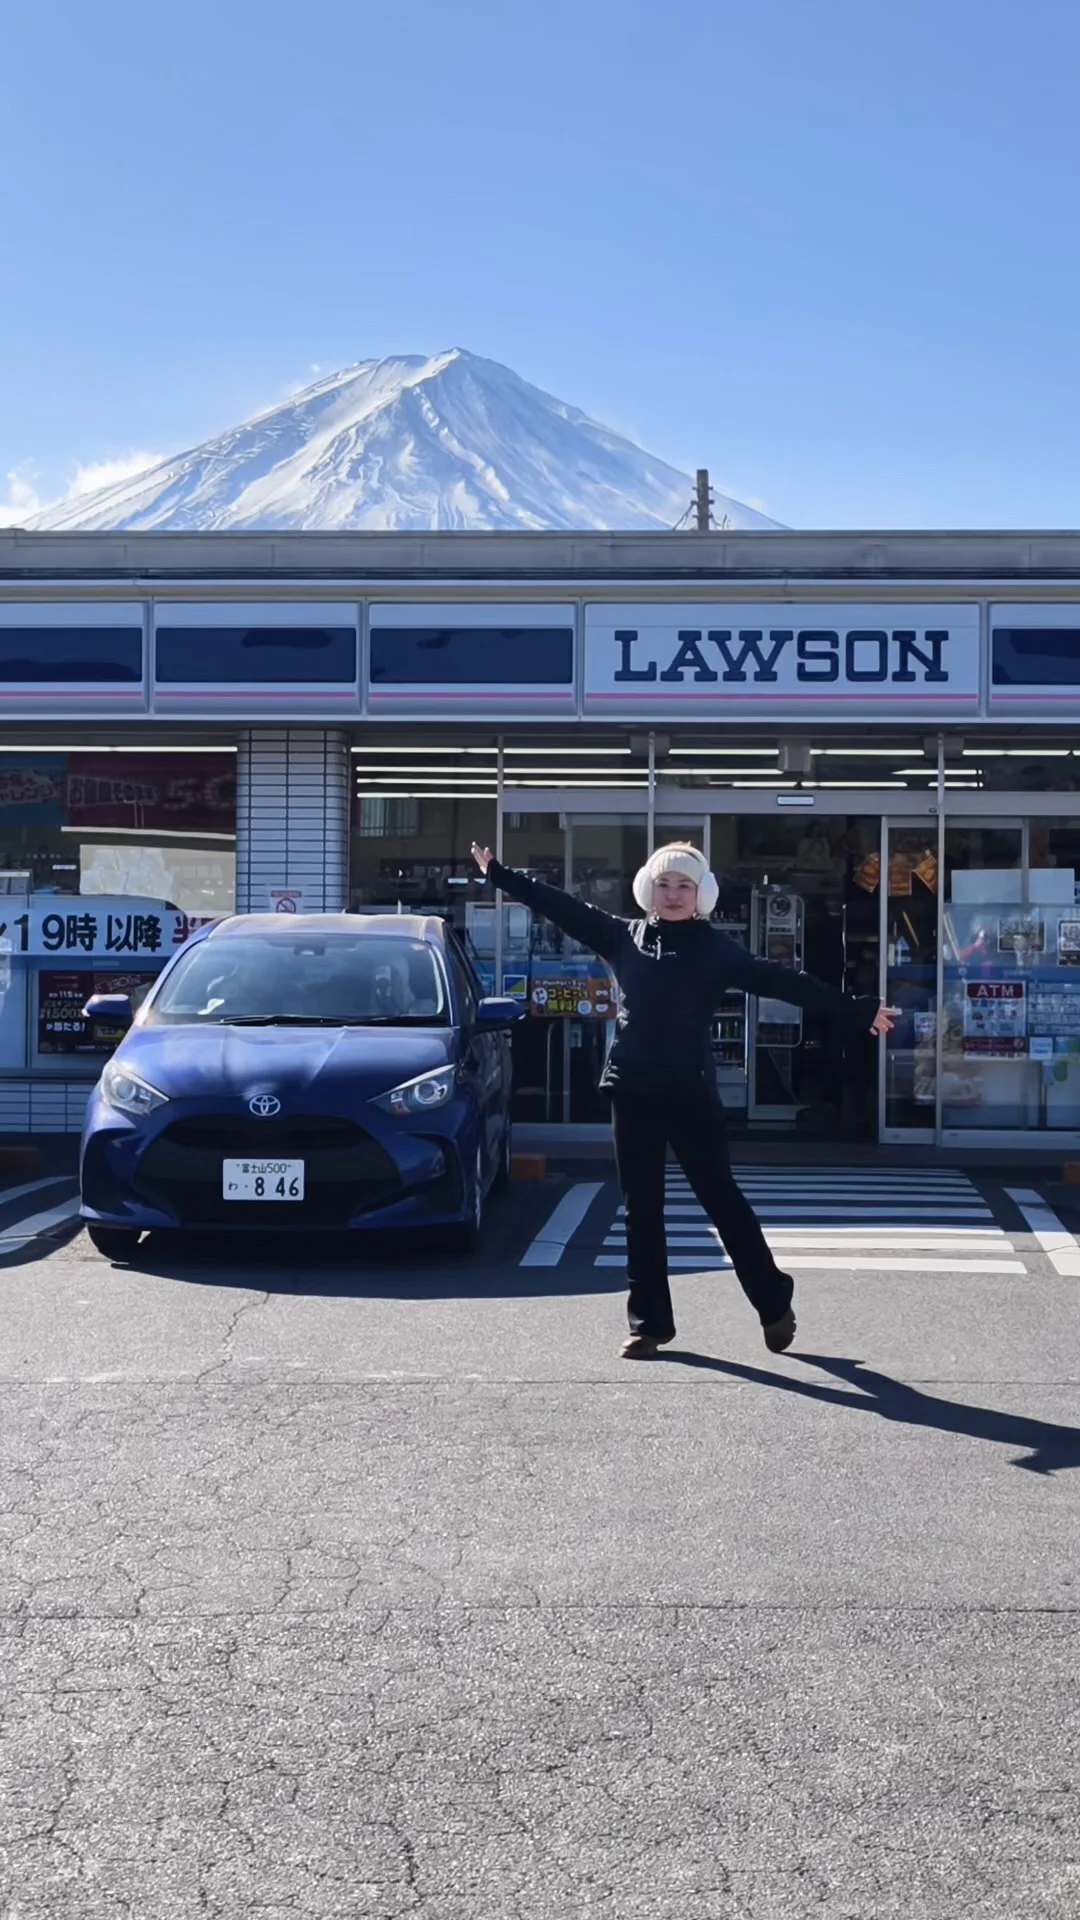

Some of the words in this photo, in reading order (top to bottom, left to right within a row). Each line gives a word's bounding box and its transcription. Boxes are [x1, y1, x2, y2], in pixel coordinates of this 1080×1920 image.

[614, 630, 949, 682] LAWSON
[976, 984, 1014, 997] ATM
[228, 1181, 238, 1191] わ
